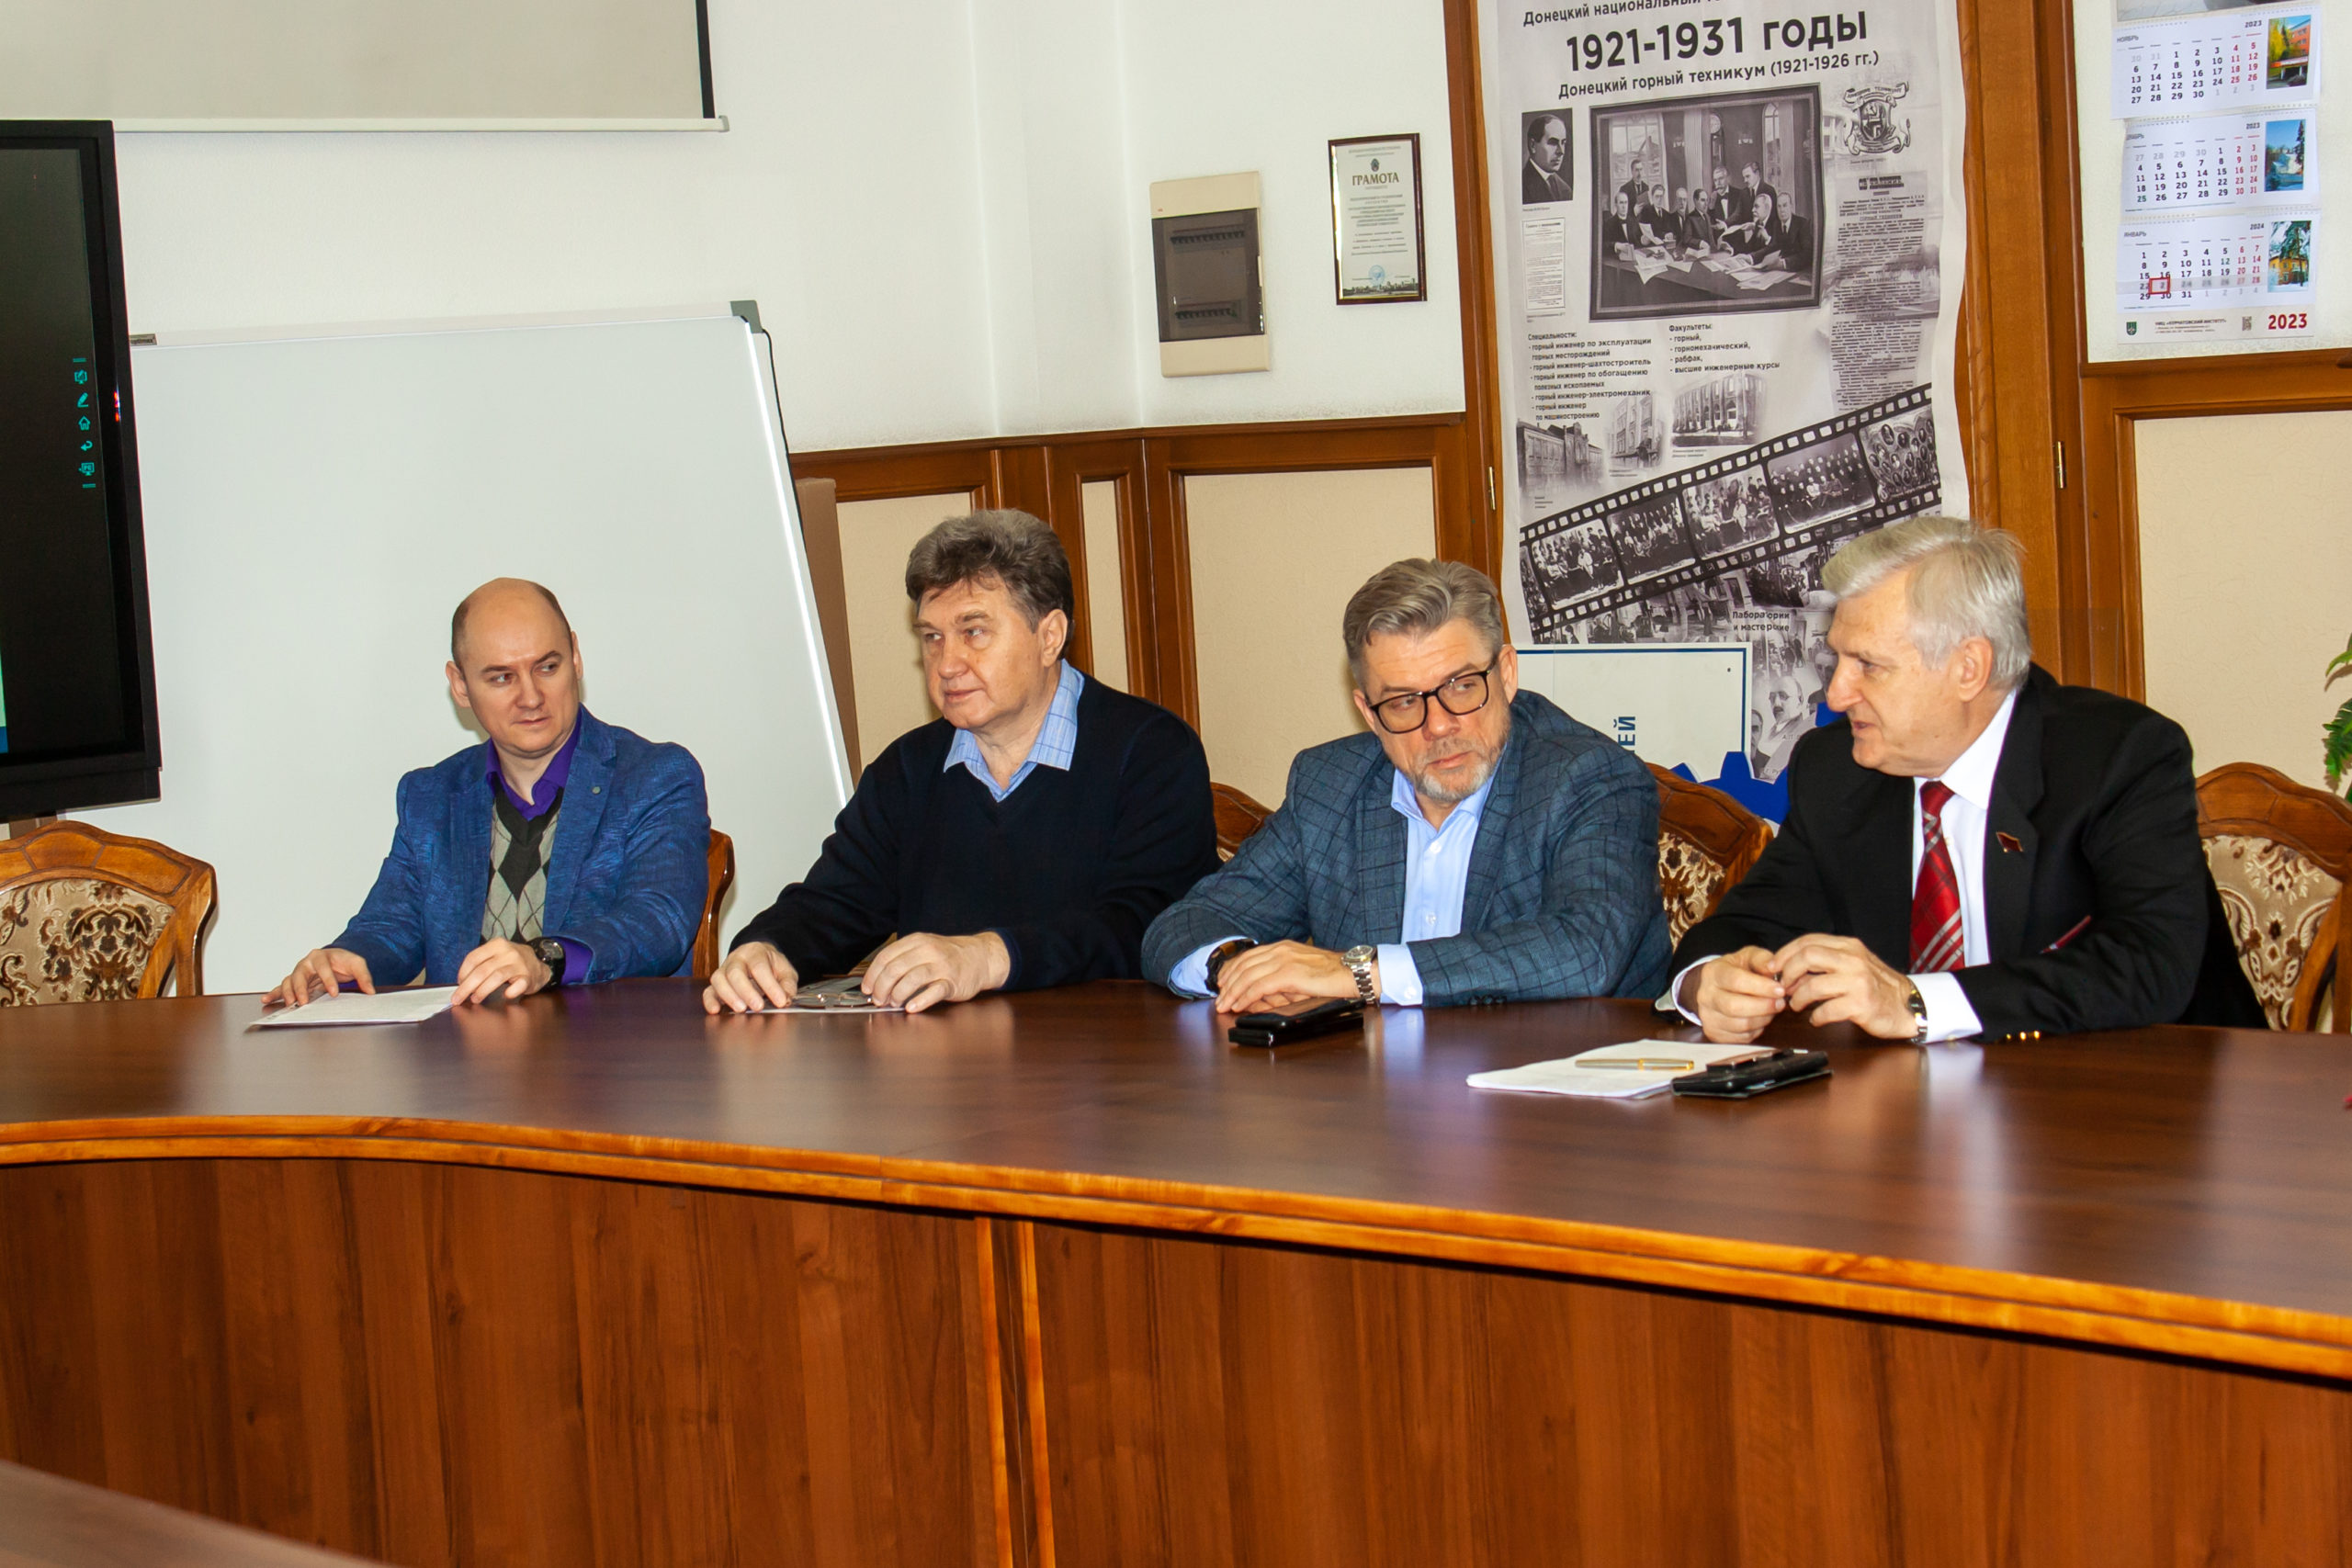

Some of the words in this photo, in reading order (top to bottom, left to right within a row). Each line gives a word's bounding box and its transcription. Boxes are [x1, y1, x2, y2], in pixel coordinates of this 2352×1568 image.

[1523, 4, 1589, 27] Донецкий
[1594, 0, 1701, 16] национальн
[1566, 17, 1743, 72] 1921-1931
[1763, 11, 1867, 51] годы
[2212, 56, 2223, 65] 10
[2231, 55, 2239, 63] 11
[2249, 52, 2258, 60] 12
[1558, 76, 1627, 100] Донецкий
[1633, 71, 1684, 91] горный
[1689, 65, 1765, 83] техникум
[1770, 53, 1849, 77] (1921-1926
[1855, 50, 1879, 66] гг.)
[2151, 73, 2161, 81] 14
[2171, 71, 2182, 79] 15
[2193, 69, 2204, 78] 16
[2213, 68, 2223, 76] 17
[2231, 65, 2240, 73] 18
[2249, 63, 2258, 71] 19
[2213, 78, 2223, 86] 24
[2230, 76, 2240, 84] 25
[2248, 73, 2258, 81] 26
[2131, 96, 2141, 104] 27
[2193, 90, 2205, 99] 30
[2251, 144, 2256, 152] 3
[2237, 156, 2241, 164] 9
[2217, 168, 2228, 176] 15
[2235, 166, 2244, 174] 16
[2250, 165, 2258, 173] 17
[1352, 172, 1399, 186] ГРАМОТА
[2197, 180, 2208, 188] 21
[2217, 178, 2228, 186] 22
[2156, 193, 2167, 202] 26
[2176, 192, 2188, 200] 27
[2198, 190, 2209, 198] 28
[2236, 187, 2244, 195] 30
[2250, 186, 2257, 194] 31
[2181, 259, 2192, 268] 10
[2238, 256, 2246, 264] 13
[2253, 255, 2261, 263] 14
[2202, 269, 2212, 277] 18
[2221, 268, 2230, 276] 19
[2237, 267, 2246, 275] 20
[2252, 266, 2260, 274] 21
[2251, 276, 2261, 284] 28
[2268, 313, 2307, 330] 2023
[1528, 332, 1577, 340] Специальности:
[1531, 342, 1554, 351] горный
[1598, 338, 1652, 347] эксплуатации
[1555, 349, 1610, 359] месторождений
[1533, 362, 1555, 371] горный
[1557, 359, 1651, 369] инженер-шахтостроитель
[1704, 363, 1754, 372] инженерные
[1757, 362, 1780, 370] курсы
[1534, 372, 1555, 381] горный
[1598, 369, 1648, 378] обогащению
[1563, 381, 1605, 389] ископаемых
[1535, 392, 1556, 401] горный
[1557, 389, 1651, 399] инженер-электромеханик
[1535, 402, 1556, 411] горный
